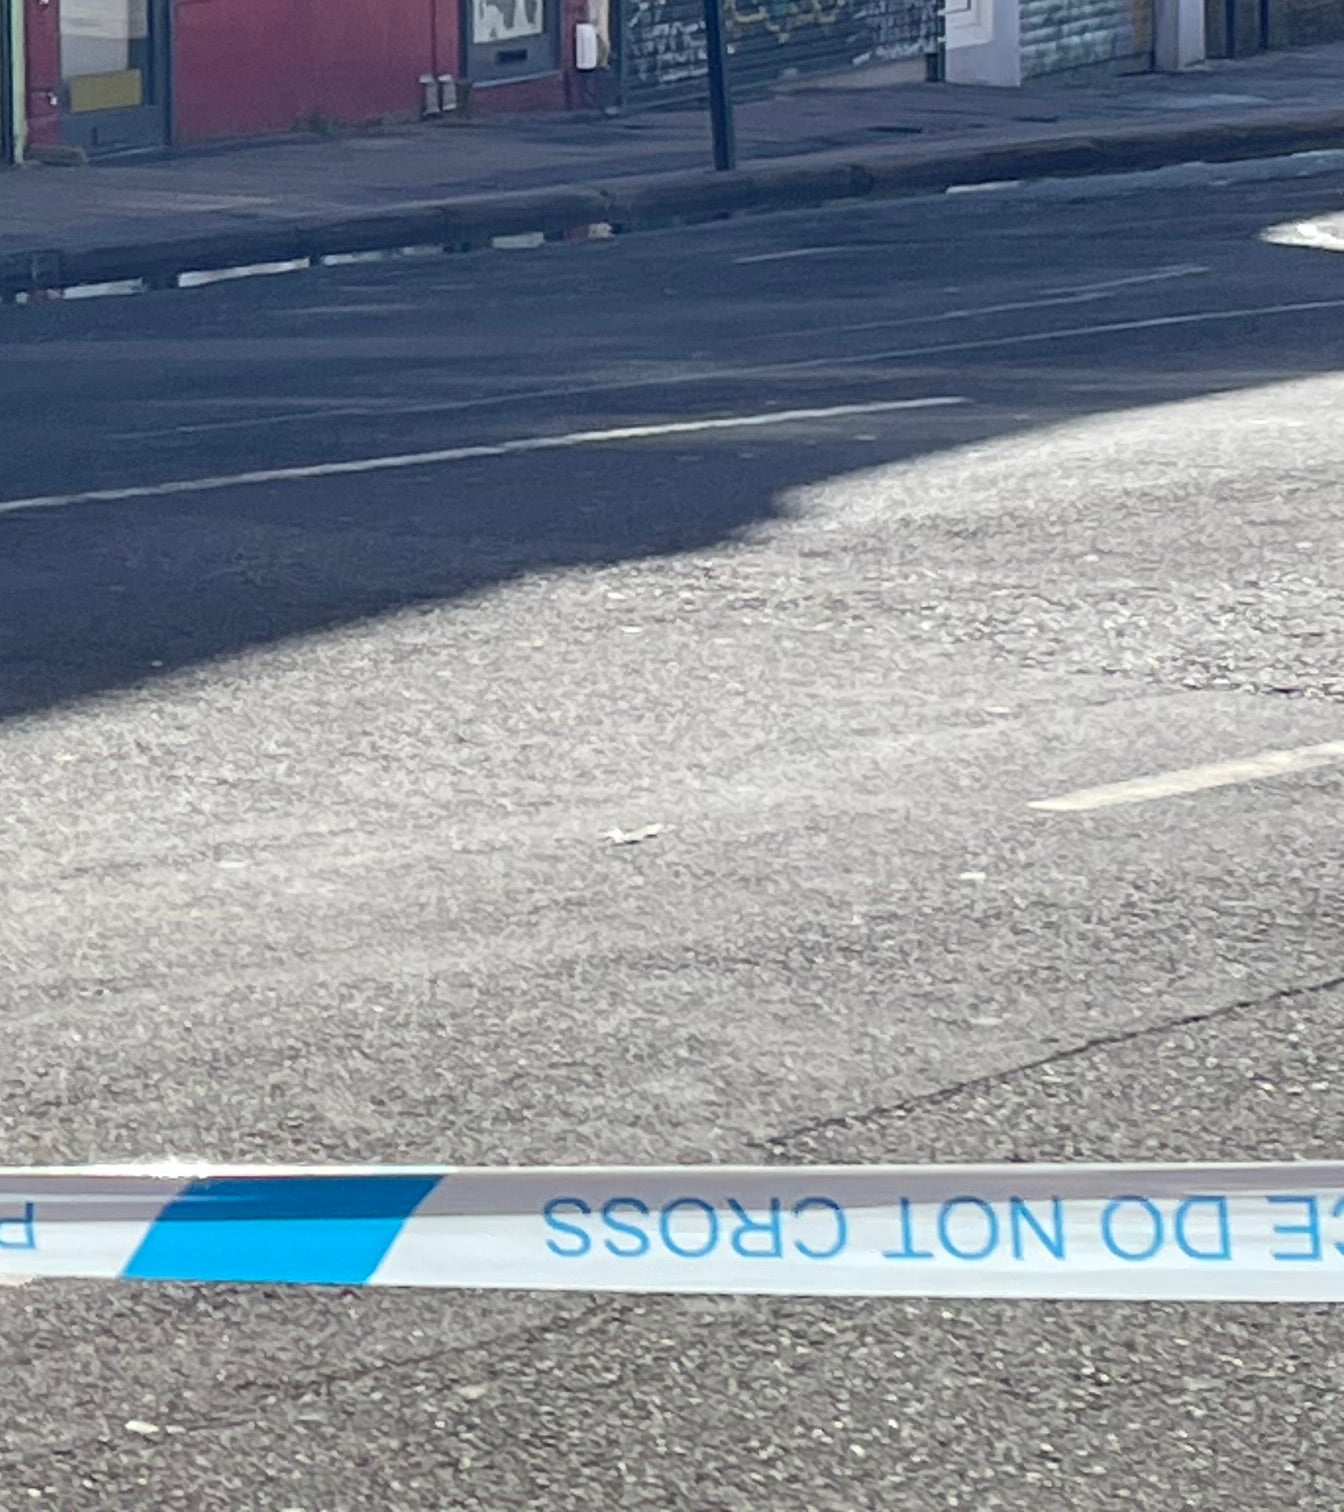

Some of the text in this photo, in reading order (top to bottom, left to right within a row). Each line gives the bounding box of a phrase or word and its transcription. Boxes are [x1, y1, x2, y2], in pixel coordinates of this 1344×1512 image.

[543, 1196, 1344, 1261] E DO NOT CROSS
